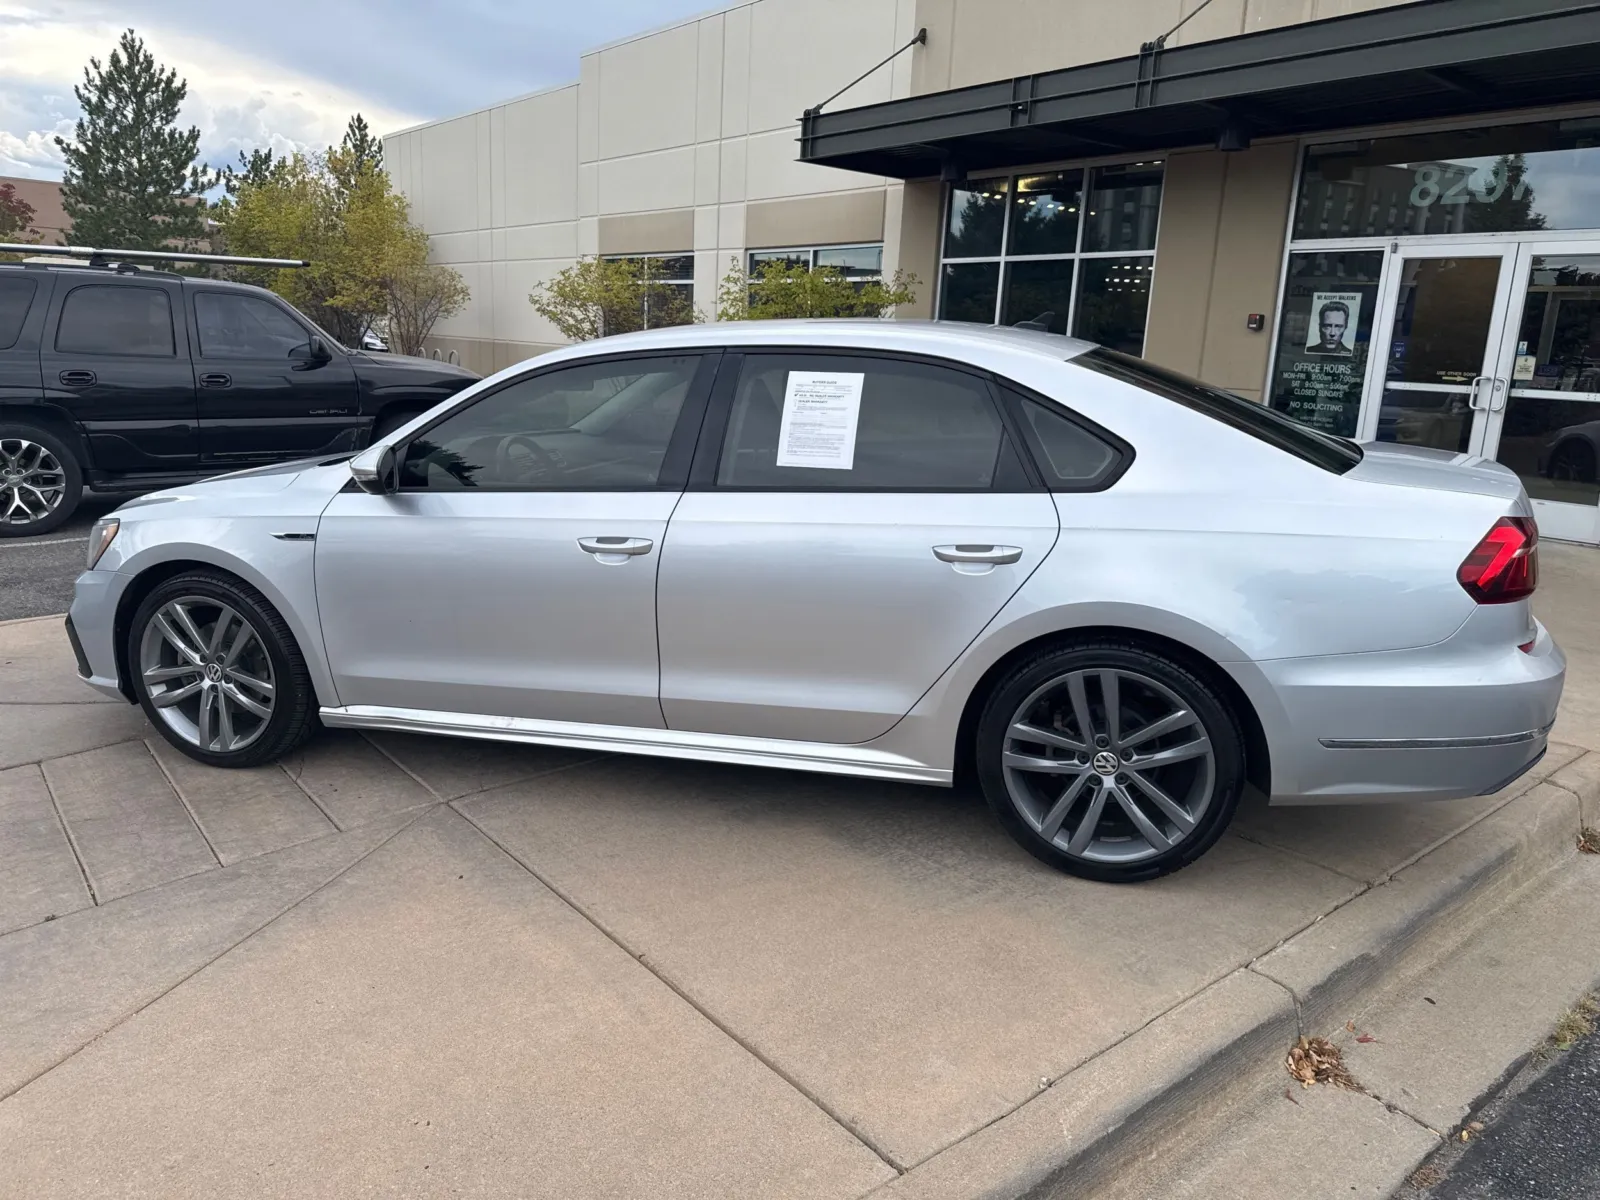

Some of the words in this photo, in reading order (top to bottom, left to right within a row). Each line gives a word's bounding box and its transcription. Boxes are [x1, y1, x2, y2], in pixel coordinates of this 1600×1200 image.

[1293, 362, 1321, 372] OFFICE
[1323, 364, 1351, 374] HOURS
[1283, 372, 1306, 380] MON-FRI
[1311, 373, 1332, 381] 9:00am
[1293, 388, 1316, 396] CLOSED
[1318, 389, 1344, 398] SUNDAYS
[1303, 402, 1343, 412] SOLICITING
